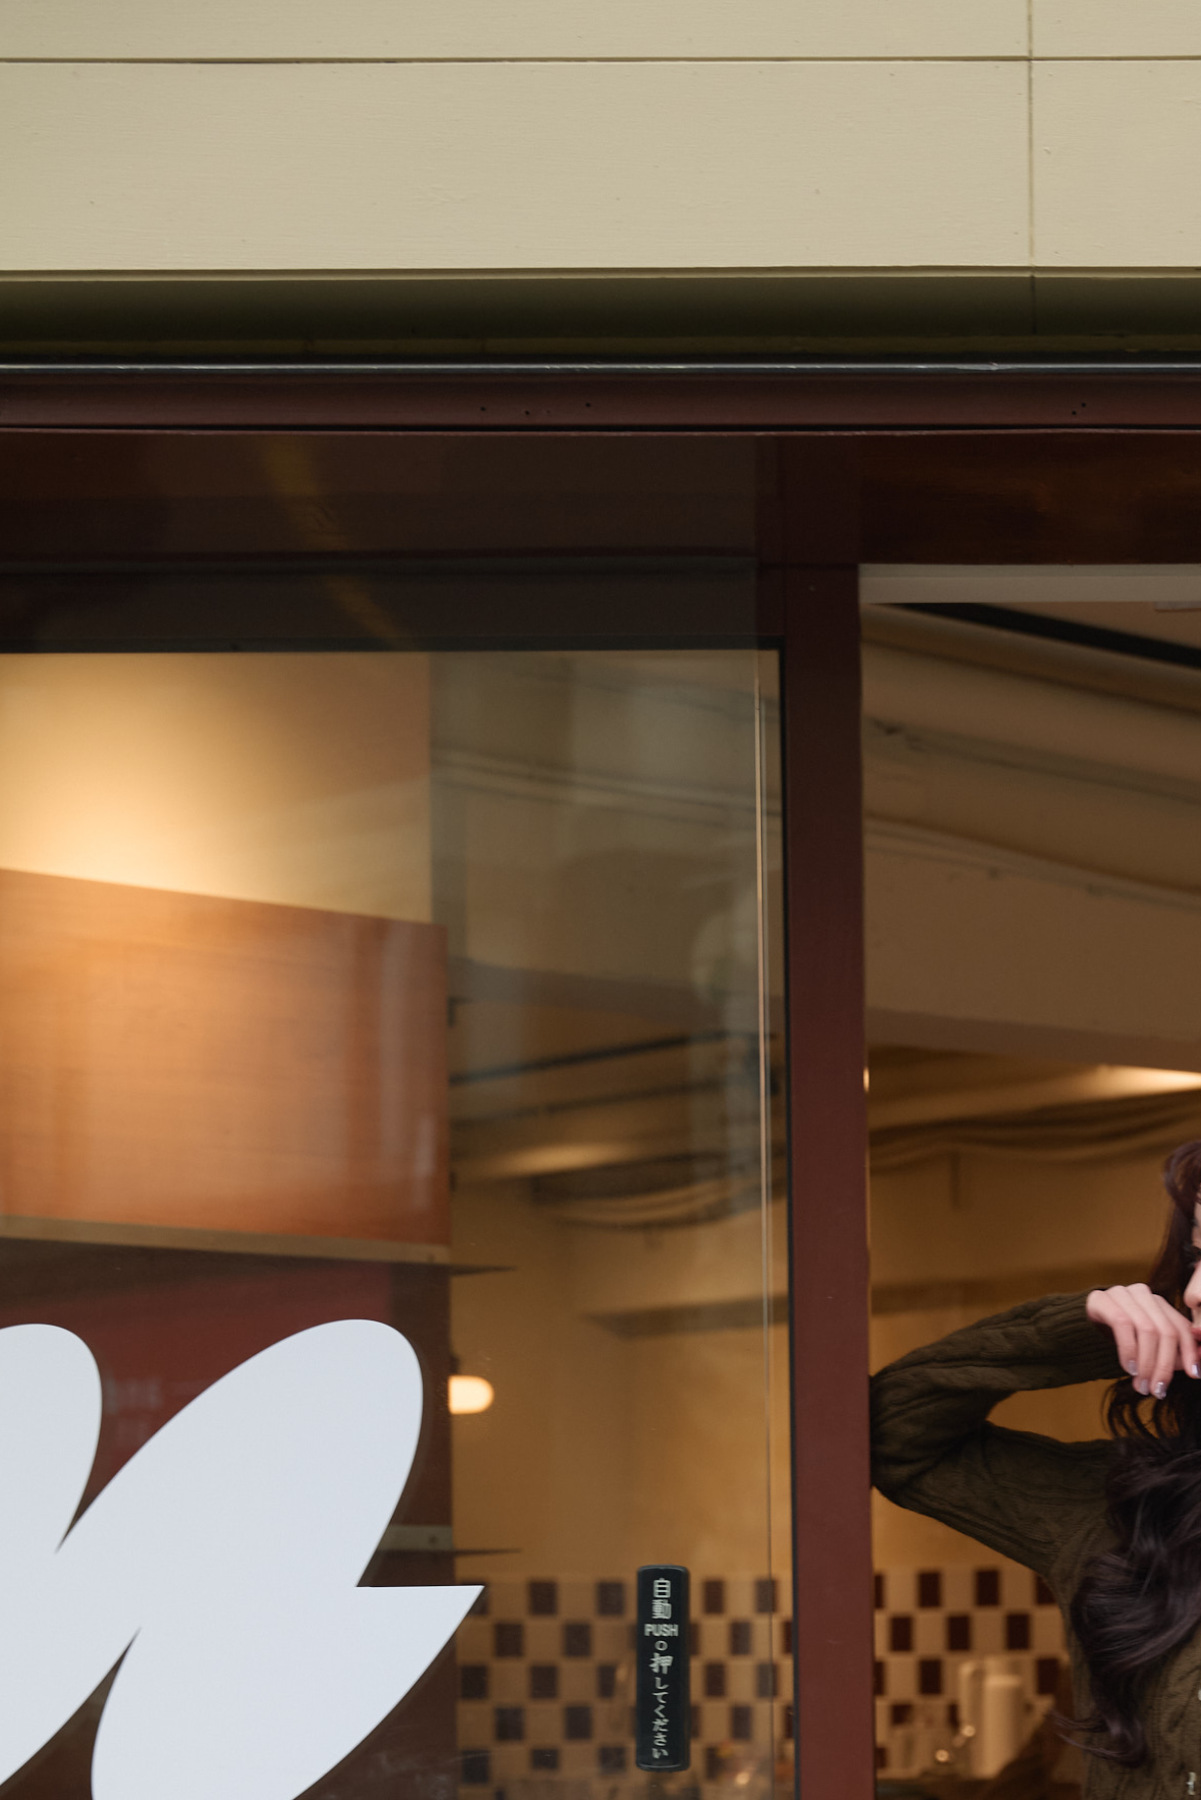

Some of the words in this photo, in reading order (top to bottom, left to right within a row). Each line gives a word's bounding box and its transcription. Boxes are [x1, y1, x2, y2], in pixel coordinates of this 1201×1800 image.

[652, 1577, 672, 1620] 自動
[644, 1623, 679, 1637] PUSH
[649, 1652, 673, 1759] 押してください
